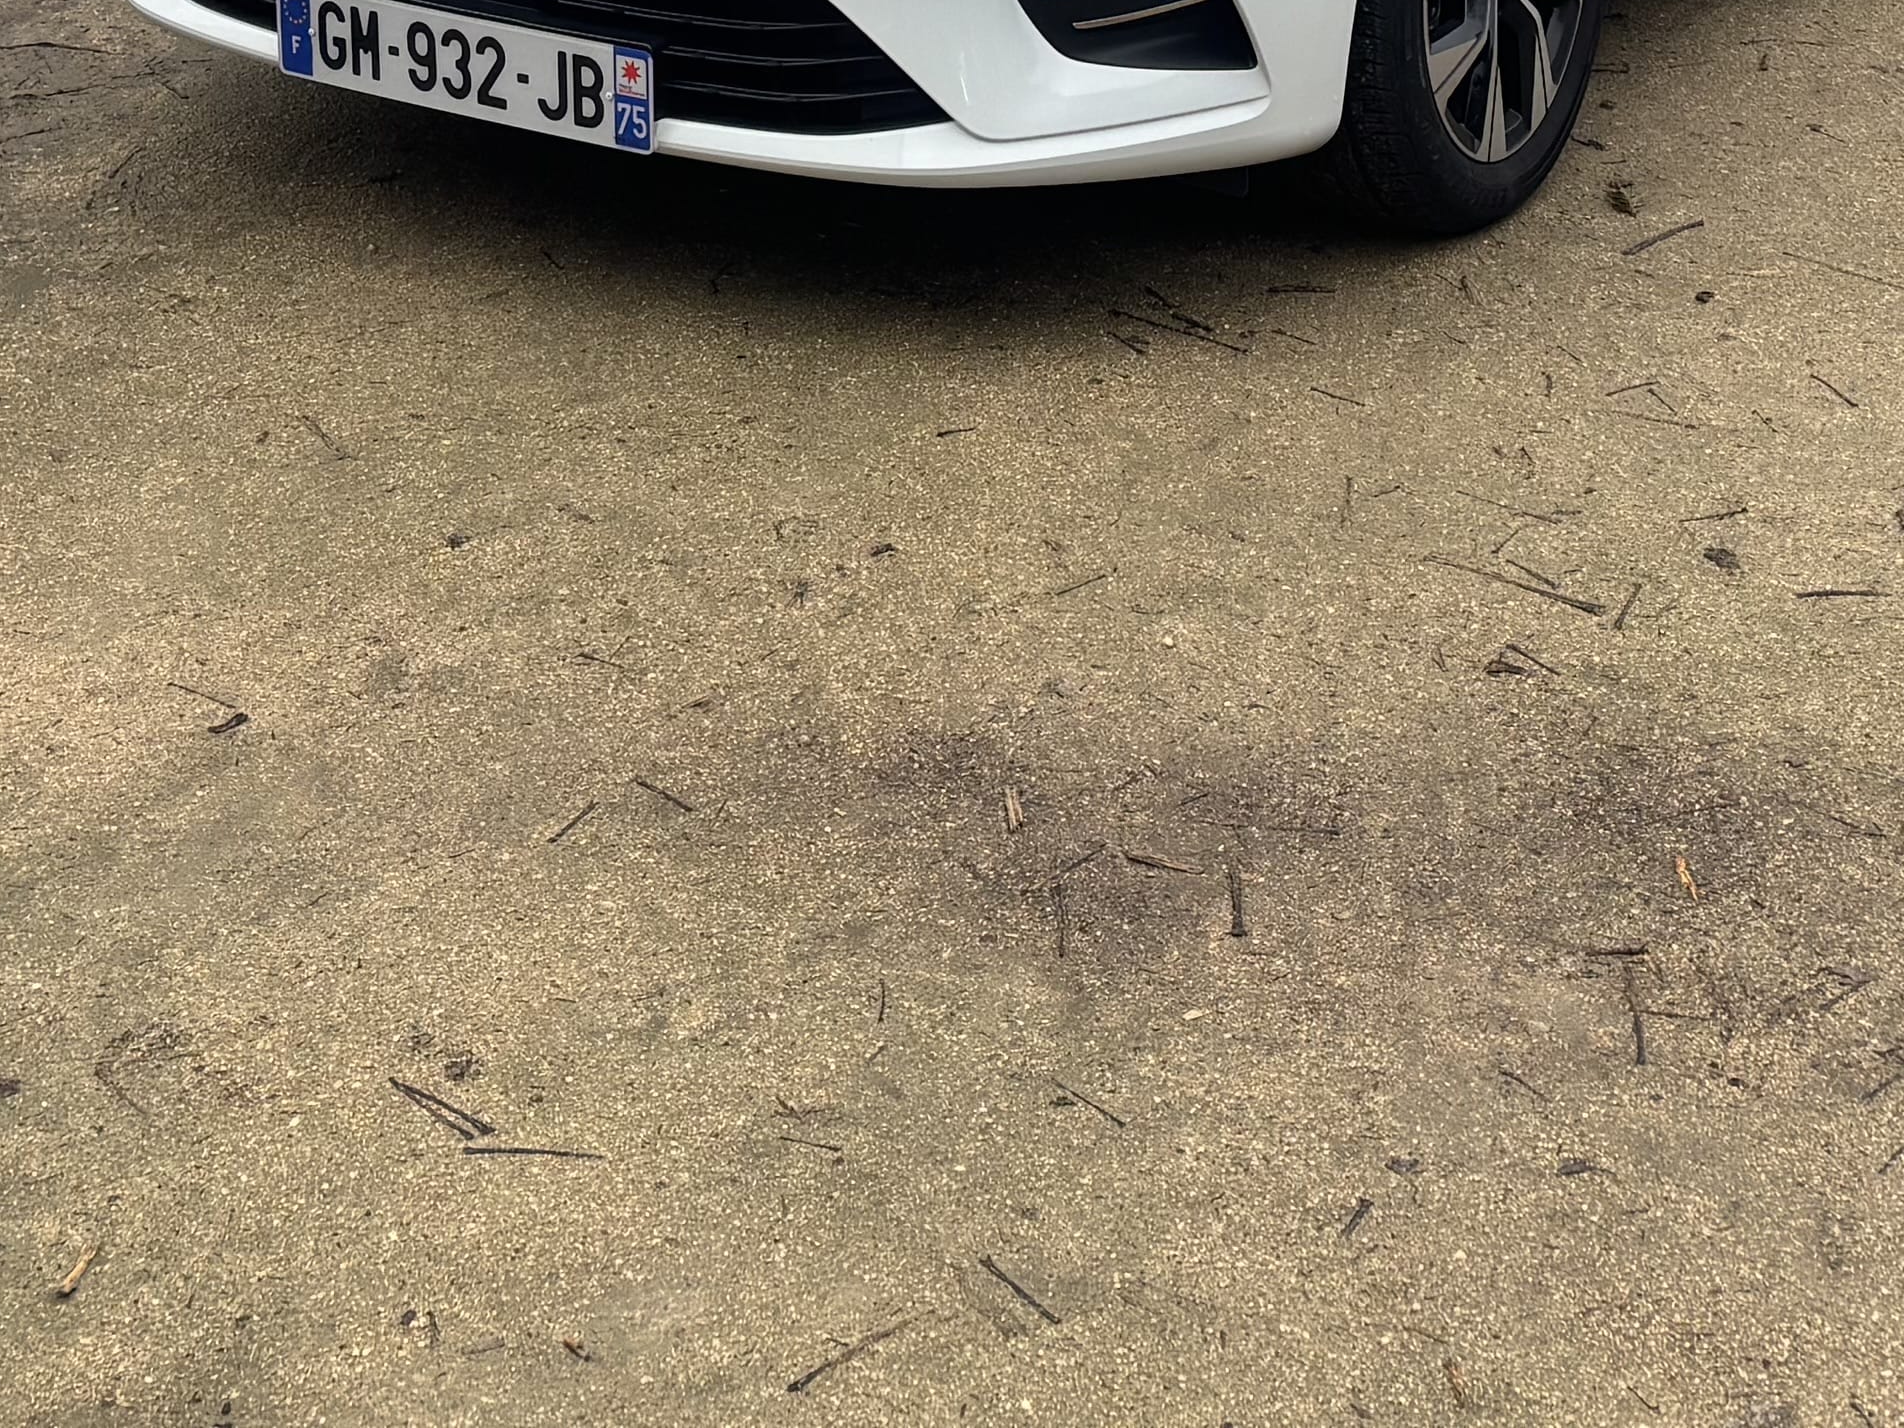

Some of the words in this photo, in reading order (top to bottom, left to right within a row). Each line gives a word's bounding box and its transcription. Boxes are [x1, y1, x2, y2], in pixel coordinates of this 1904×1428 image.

[290, 34, 302, 55] F
[317, 0, 605, 129] GM-932-JB
[617, 101, 647, 139] 75
